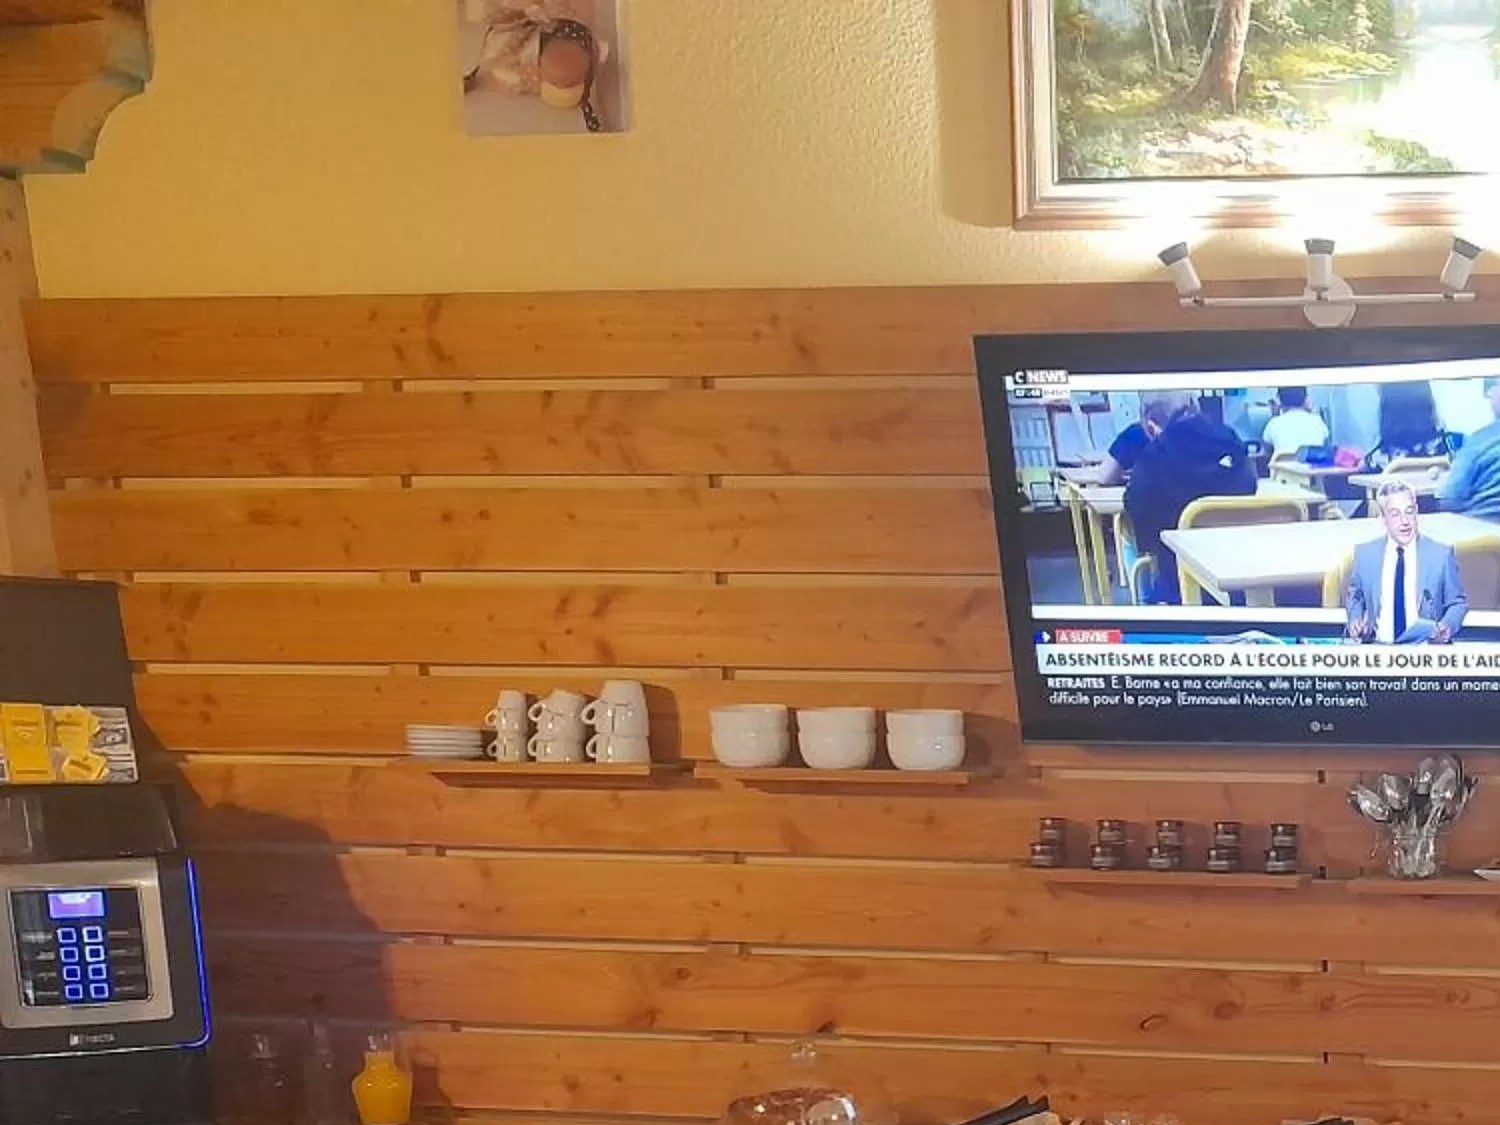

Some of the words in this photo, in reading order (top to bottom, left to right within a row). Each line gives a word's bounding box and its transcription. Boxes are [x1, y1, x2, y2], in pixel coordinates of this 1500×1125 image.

[1028, 369, 1068, 383] NEWS
[1070, 631, 1109, 643] SUIVRE
[1046, 651, 1155, 667] ABSENTÉISME
[1159, 653, 1225, 667] RECORD
[1312, 654, 1360, 668] POUR
[1365, 654, 1381, 668] LE
[1387, 654, 1432, 668] JOUR
[1438, 655, 1457, 668] DE
[1048, 677, 1105, 689] RETRAITES
[1183, 680, 1202, 690] ma
[1269, 678, 1290, 690] elle
[1315, 678, 1342, 690] bien
[1345, 680, 1367, 690] son
[1369, 678, 1407, 691] travail
[1411, 678, 1441, 691] dans
[1443, 681, 1459, 691] un
[1050, 692, 1089, 705] difficile
[1093, 695, 1121, 708] pour
[1123, 692, 1135, 705] le
